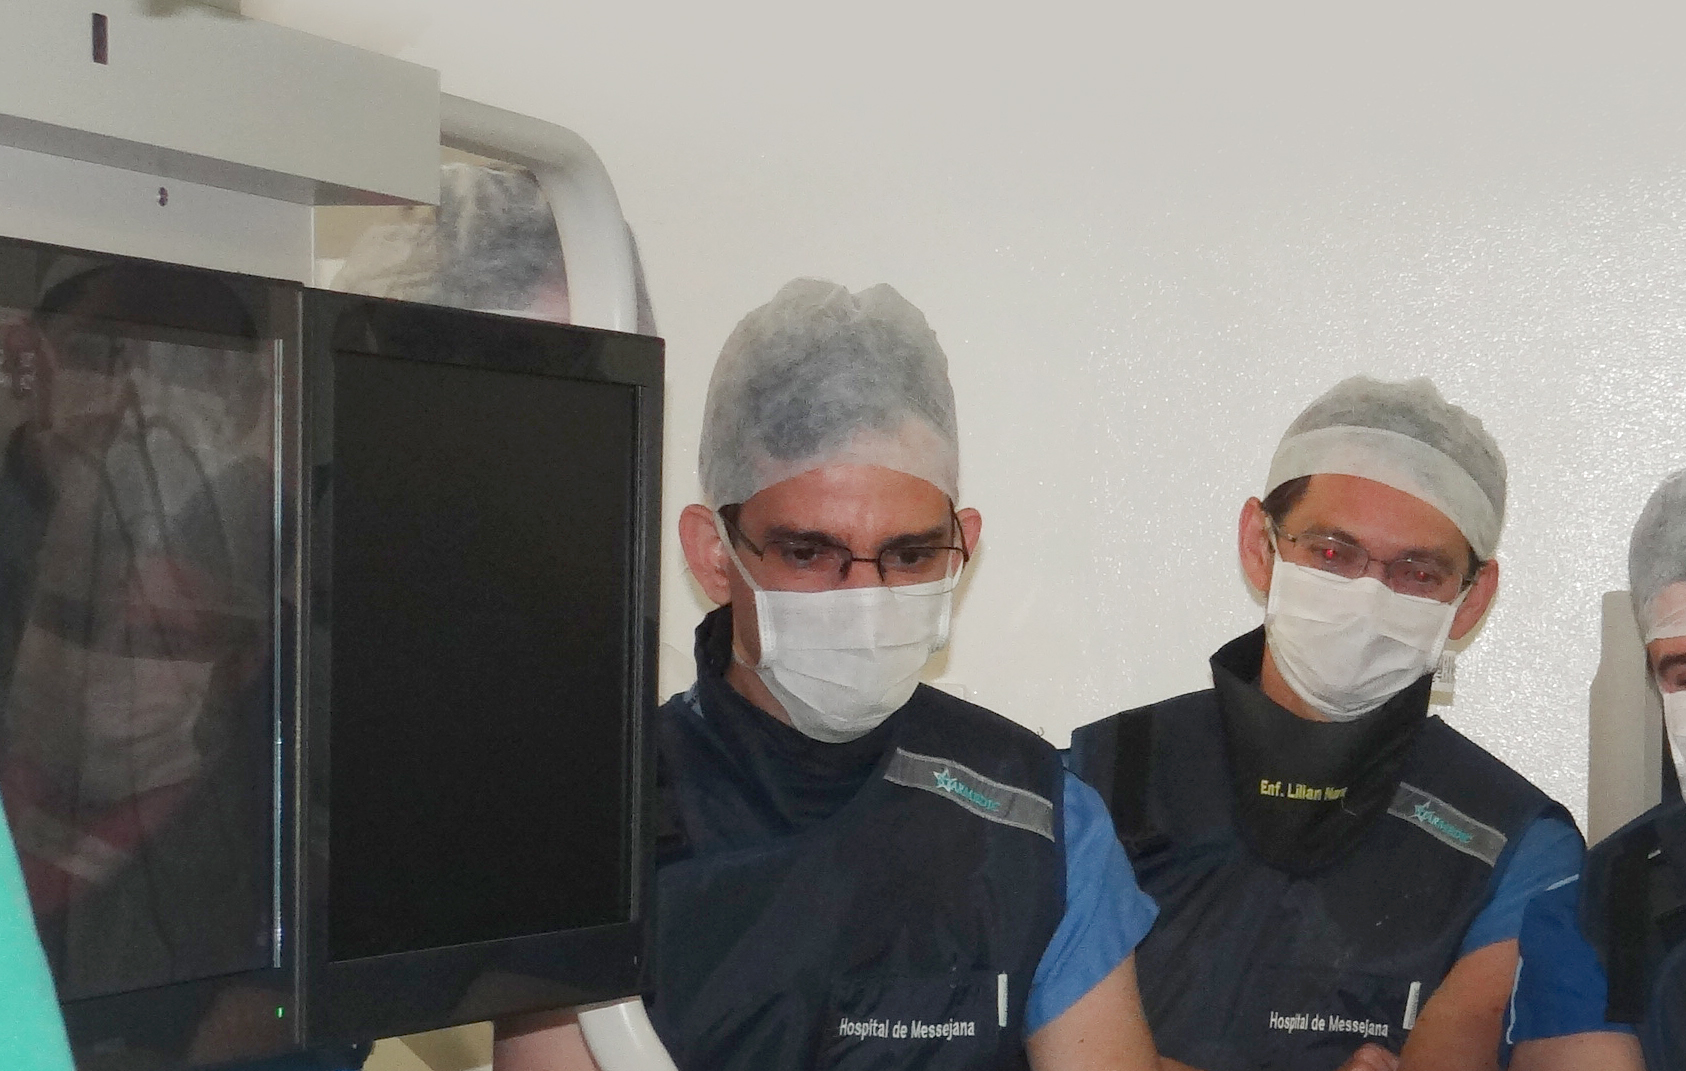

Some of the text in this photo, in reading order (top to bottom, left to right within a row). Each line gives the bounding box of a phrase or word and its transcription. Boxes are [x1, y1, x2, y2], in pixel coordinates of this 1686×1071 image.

[839, 1017, 976, 1041] Hospital de Messejana
[1269, 1010, 1389, 1038] Hospital de Messejana
